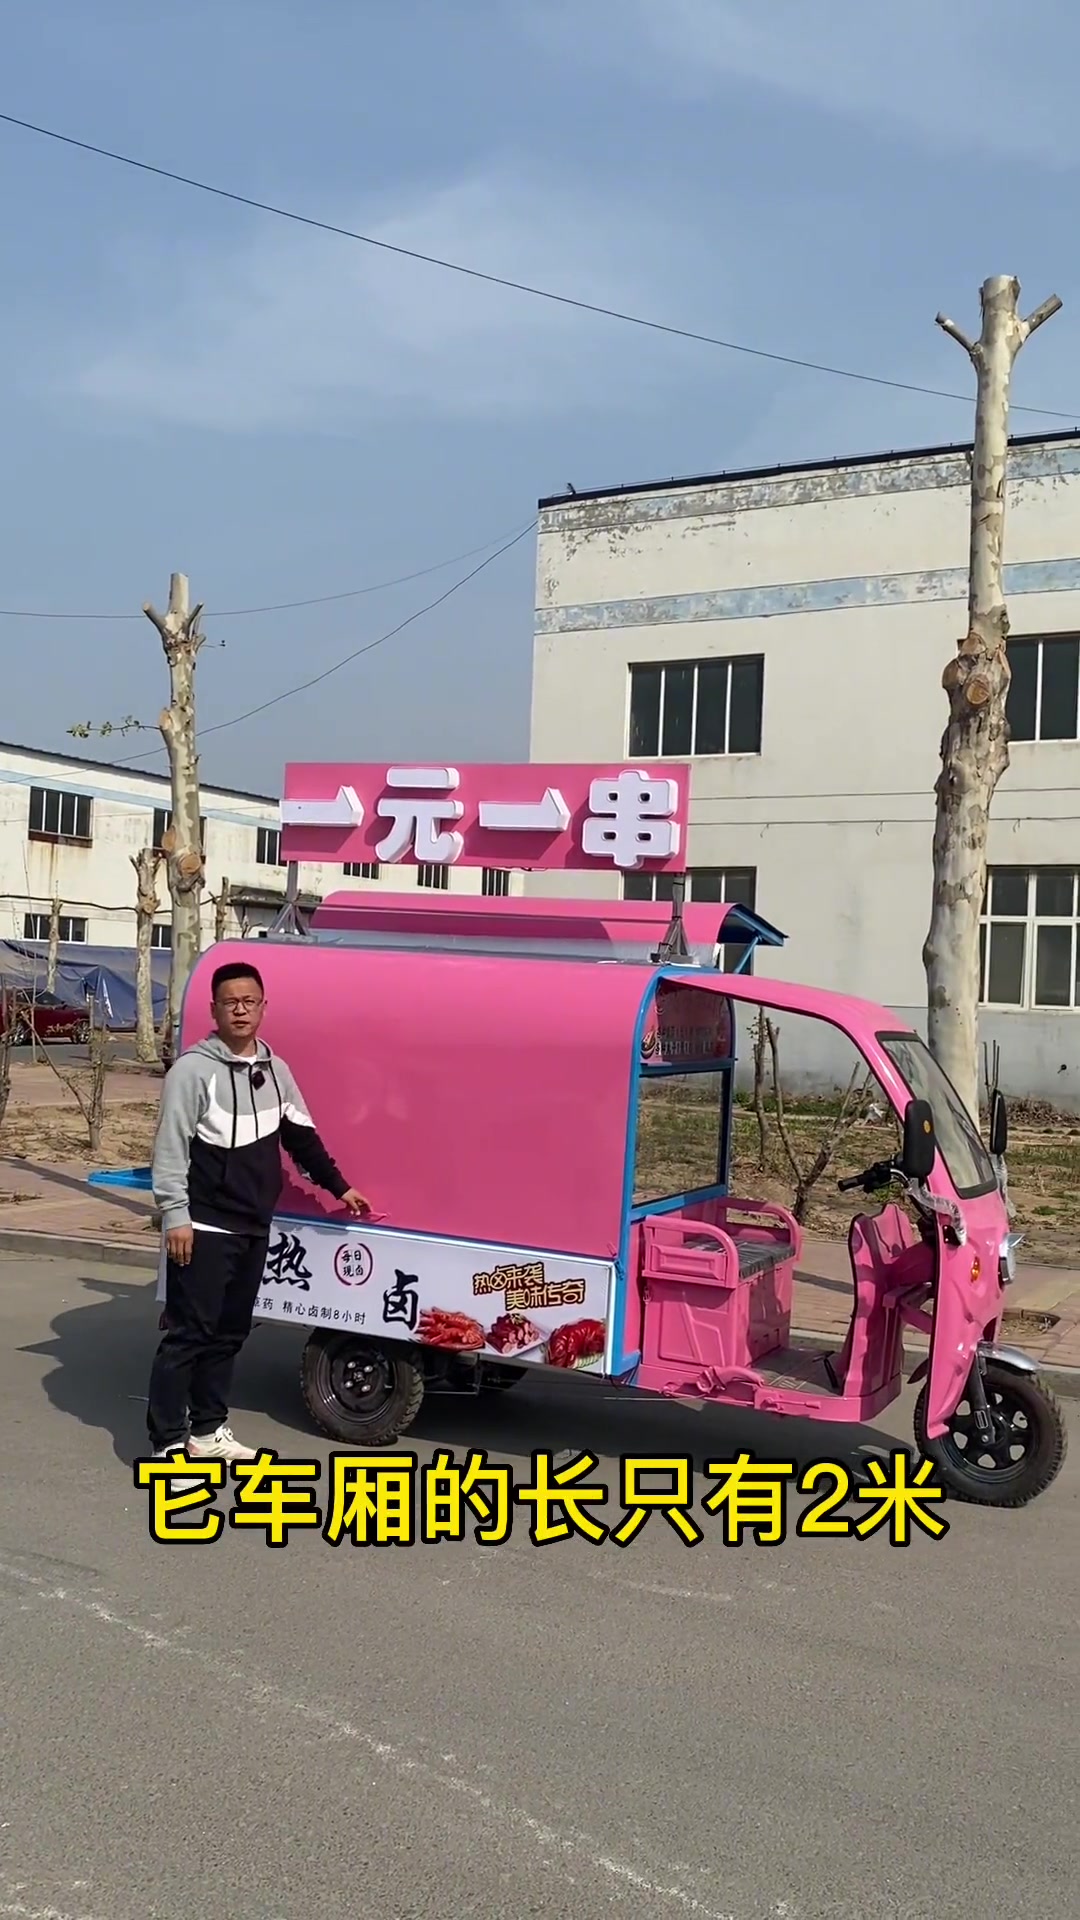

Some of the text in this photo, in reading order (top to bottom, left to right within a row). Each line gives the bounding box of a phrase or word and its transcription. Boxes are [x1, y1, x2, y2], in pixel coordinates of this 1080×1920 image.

[279, 767, 681, 868] 一元一串
[262, 1232, 419, 1331] 热 卤
[473, 1261, 544, 1295] 热卤来袭
[505, 1279, 586, 1311] 美味传奇
